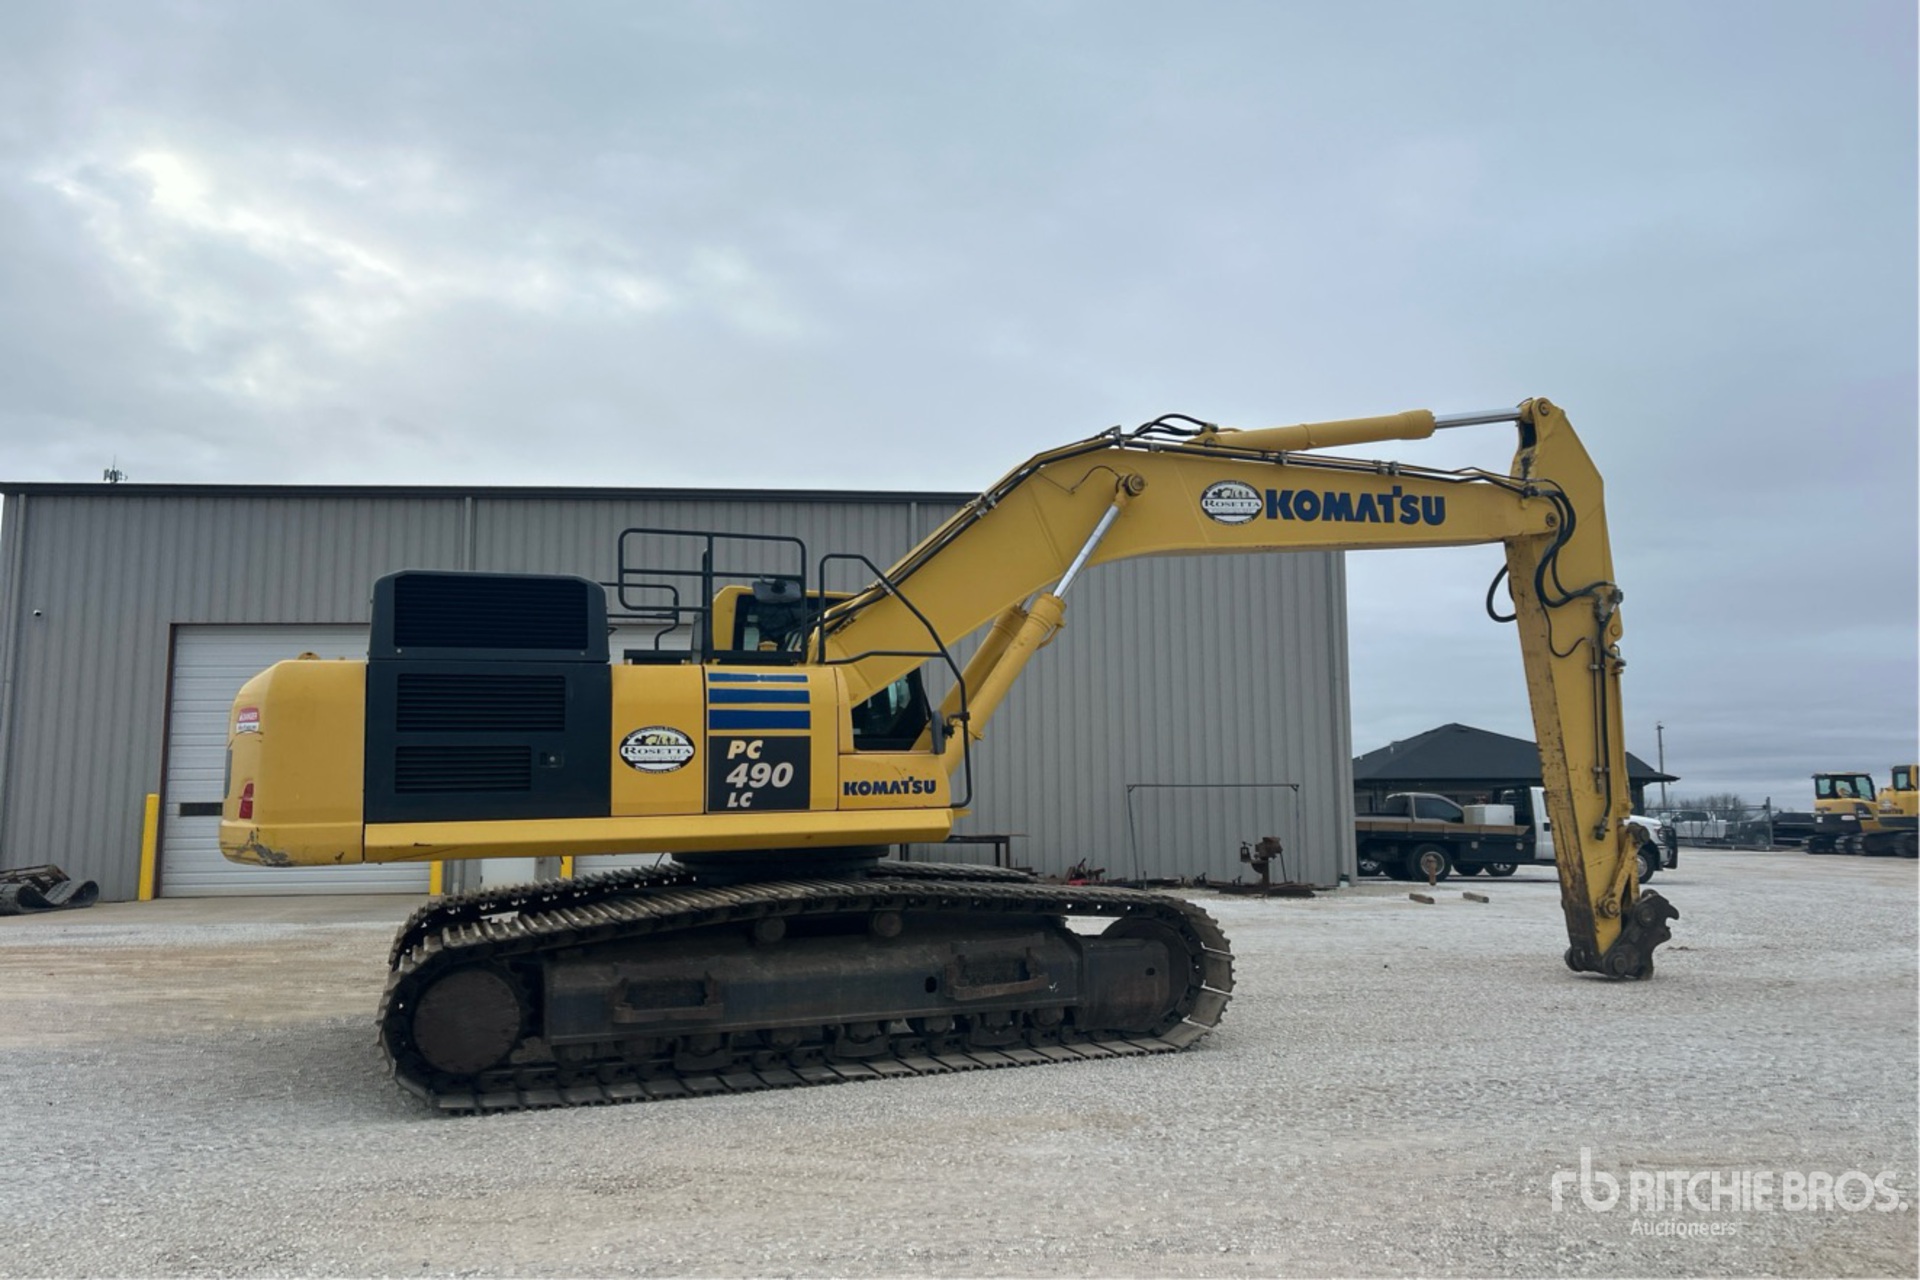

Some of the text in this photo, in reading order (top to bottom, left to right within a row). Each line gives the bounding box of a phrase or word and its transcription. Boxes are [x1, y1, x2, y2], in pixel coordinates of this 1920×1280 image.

[1203, 499, 1261, 508] ROSETTA
[1265, 485, 1446, 526] KOMATSU
[624, 746, 692, 755] ROSETTA
[726, 739, 764, 760] PC
[725, 762, 794, 789] 490
[843, 775, 937, 796] KOMATSU
[726, 791, 753, 808] LC
